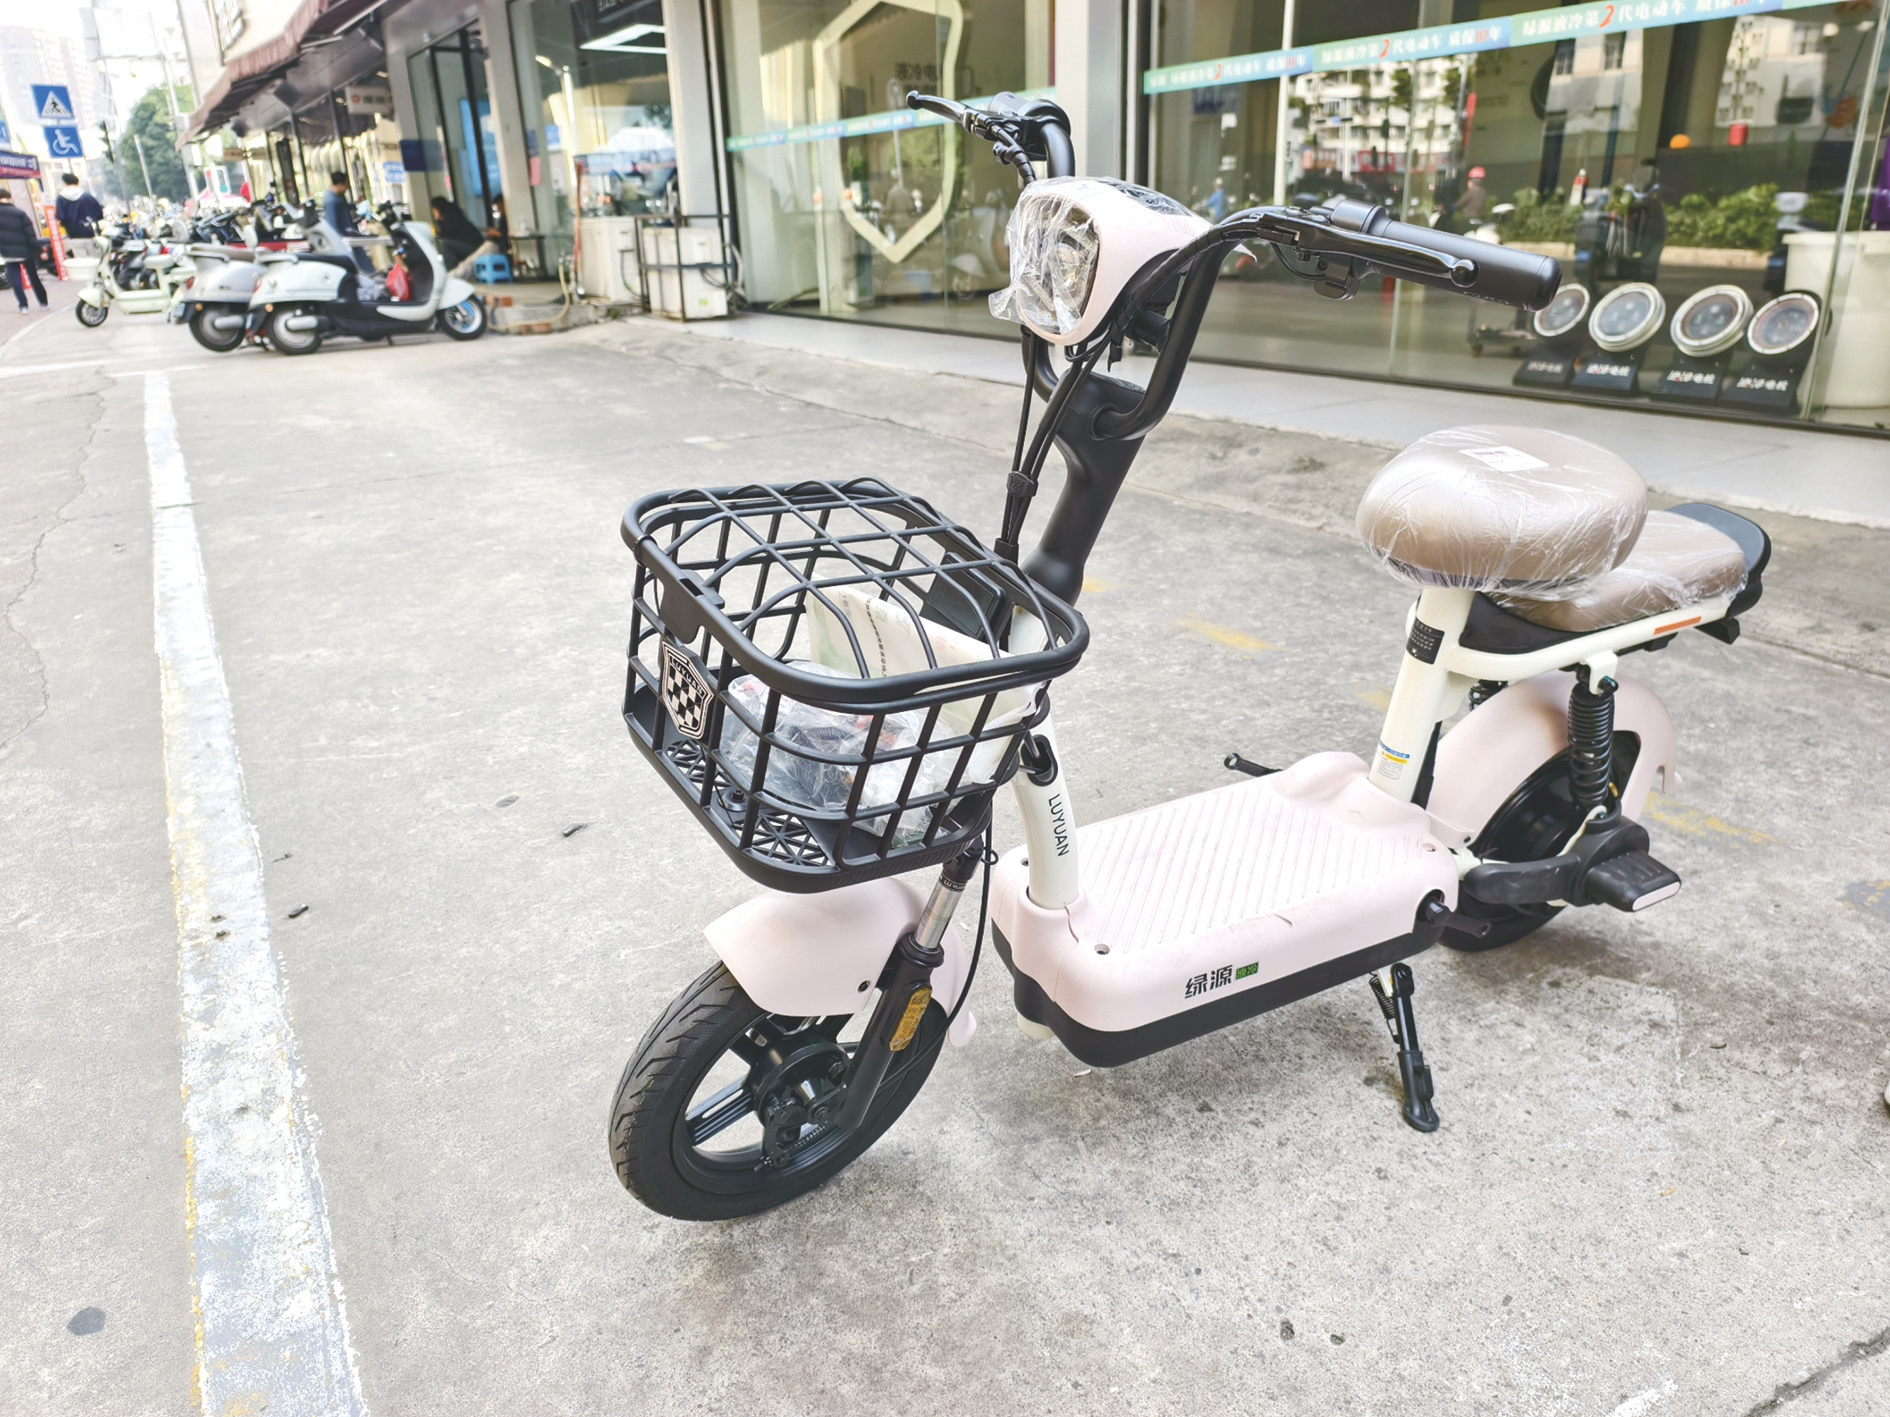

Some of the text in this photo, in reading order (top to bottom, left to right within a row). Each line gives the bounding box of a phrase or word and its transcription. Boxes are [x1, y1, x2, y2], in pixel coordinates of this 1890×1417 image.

[670, 657, 704, 695] LUYUAN
[1048, 793, 1070, 857] LUYUAN
[1184, 964, 1233, 999] 绿源
